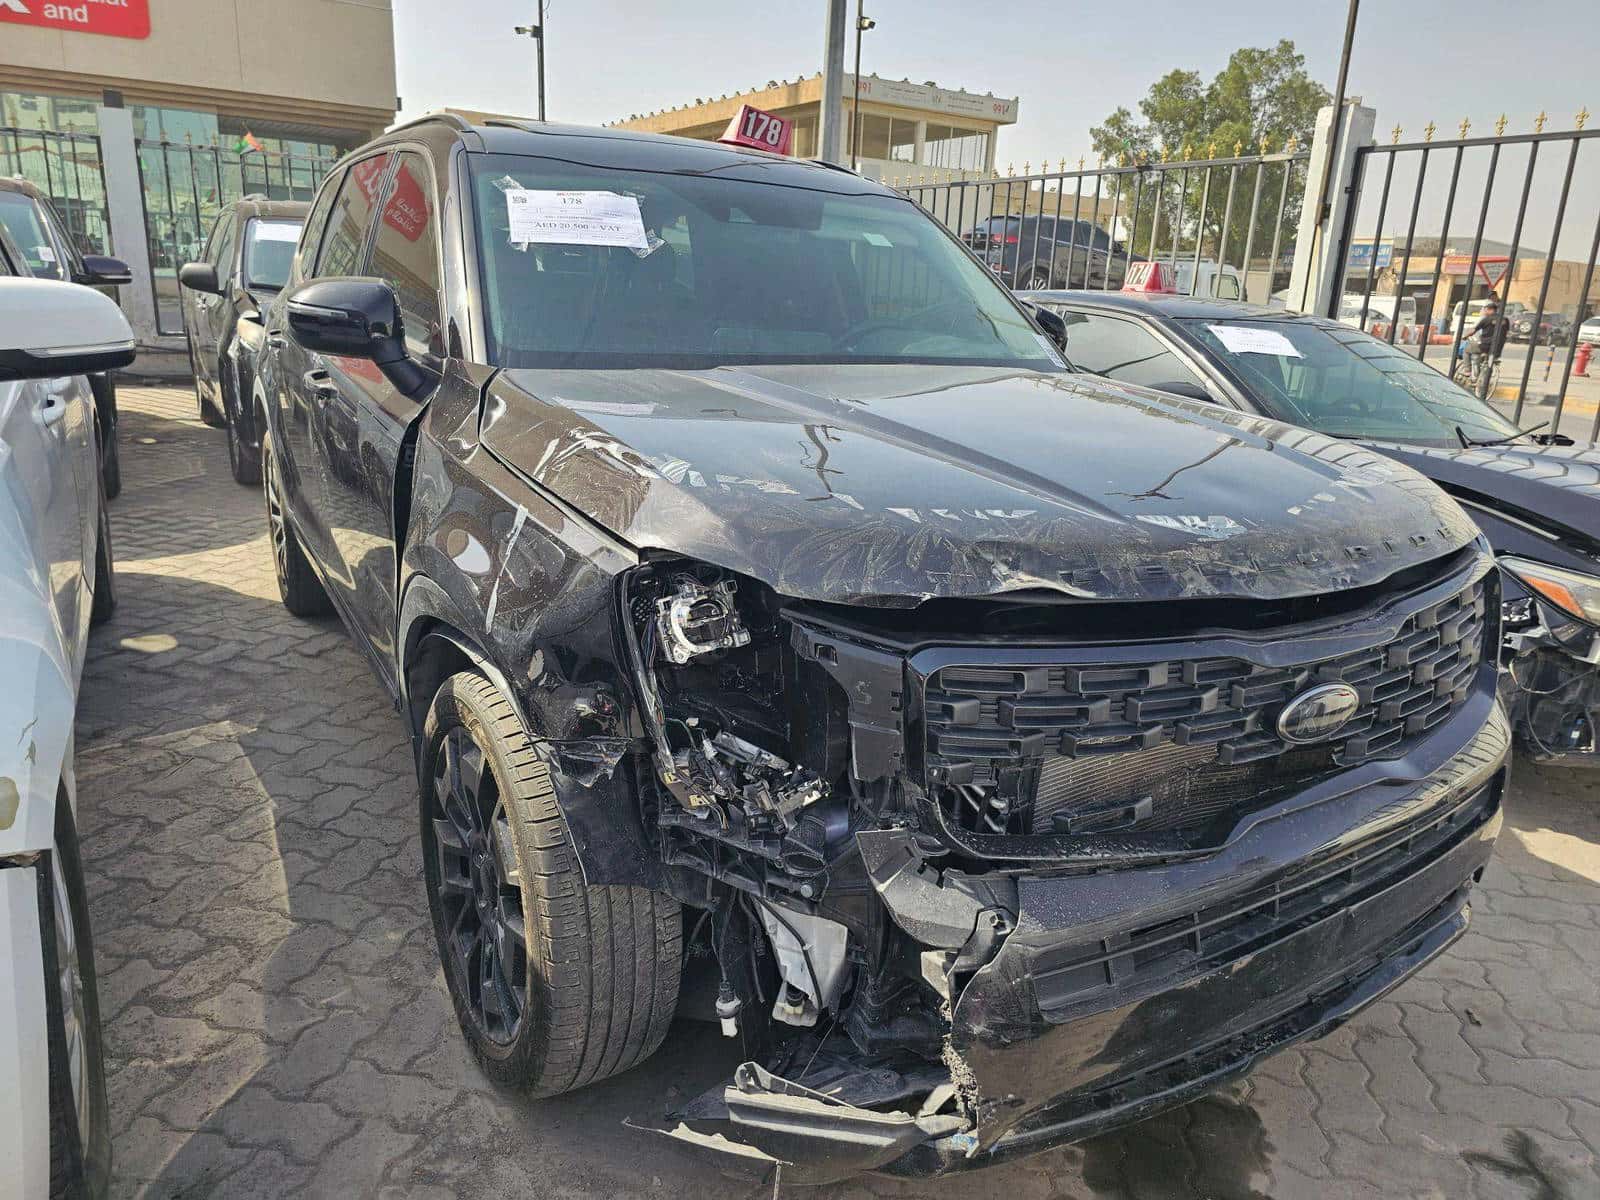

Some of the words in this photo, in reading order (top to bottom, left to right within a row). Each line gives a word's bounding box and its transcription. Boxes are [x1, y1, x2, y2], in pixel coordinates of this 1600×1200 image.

[44, 3, 88, 24] and
[746, 111, 782, 146] 178
[562, 197, 583, 205] 178
[535, 221, 557, 229] AED
[600, 224, 622, 232] VAT
